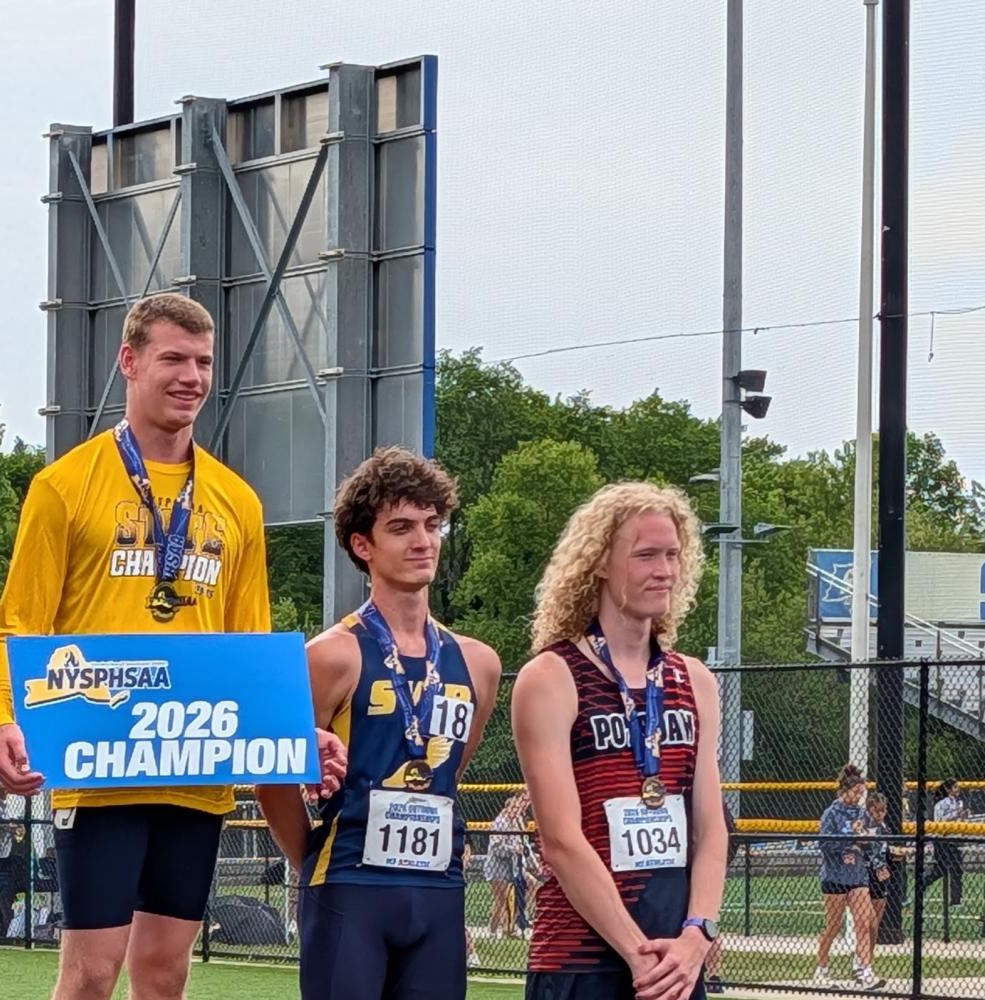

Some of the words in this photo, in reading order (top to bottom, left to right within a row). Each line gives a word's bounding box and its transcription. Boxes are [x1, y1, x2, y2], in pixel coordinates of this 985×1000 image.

[109, 549, 222, 587] CHAPION
[47, 666, 170, 690] NYSPHSAA
[128, 700, 239, 740] 2026
[436, 700, 468, 740] 18
[63, 737, 307, 780] CHAMPION
[379, 824, 440, 857] 1181
[621, 827, 681, 857] 1034
